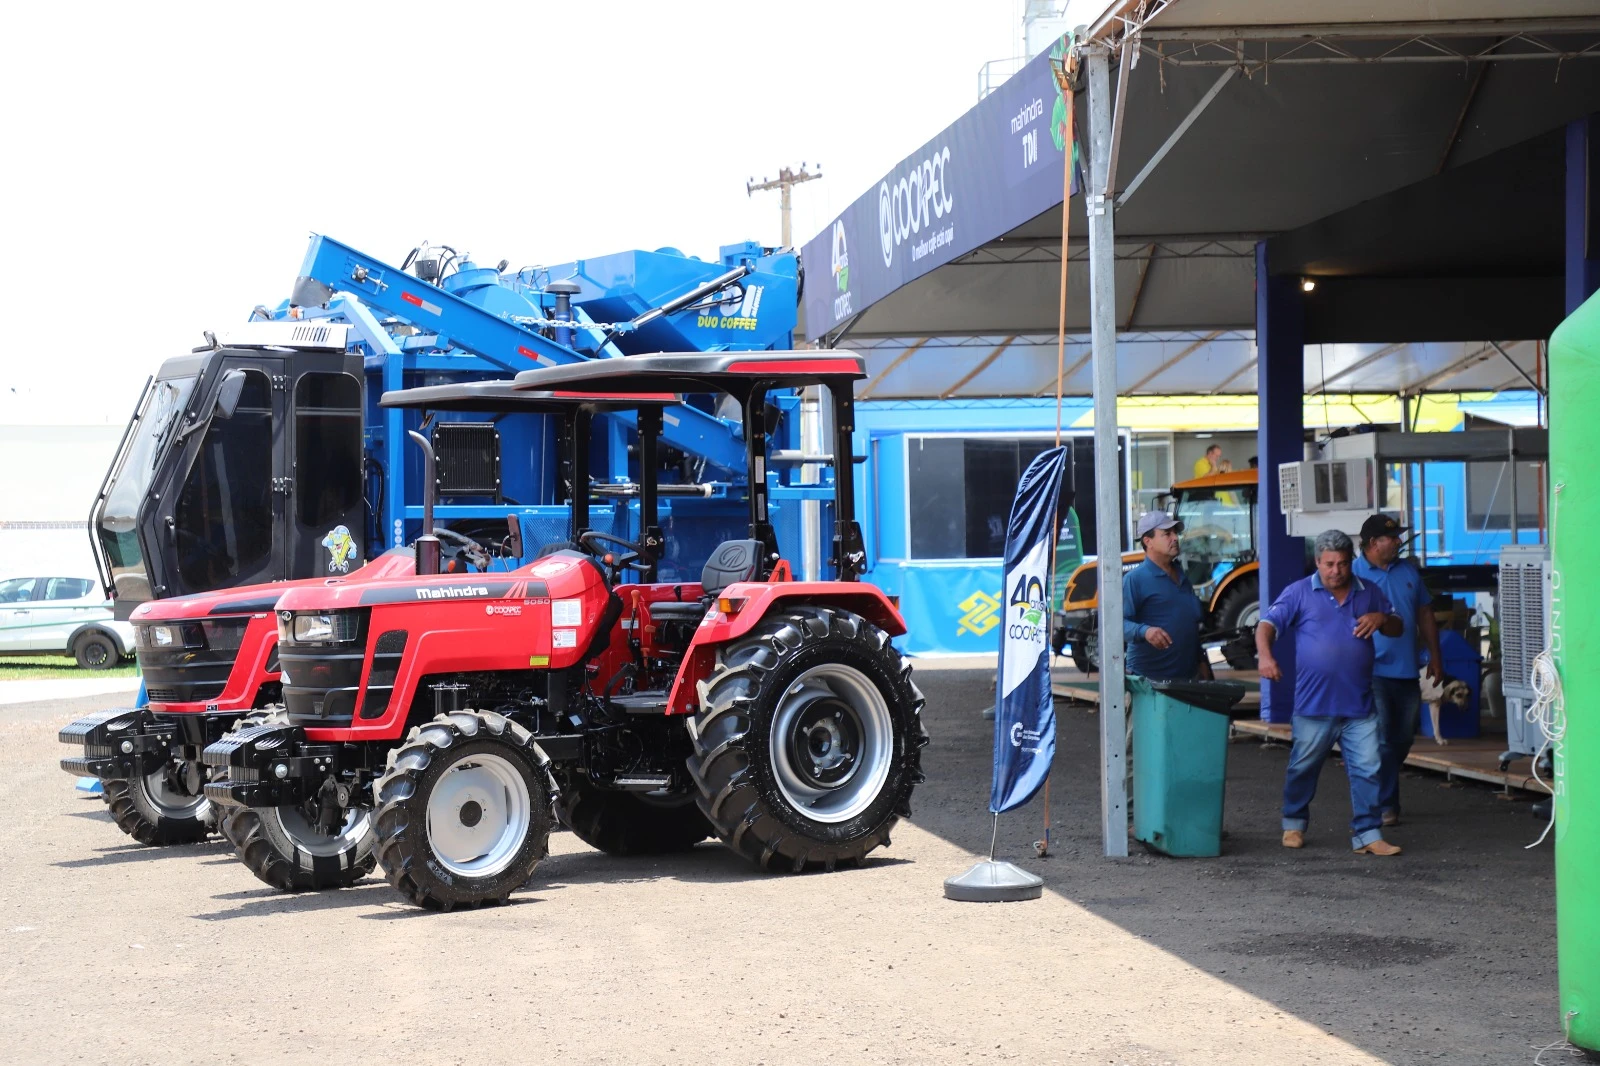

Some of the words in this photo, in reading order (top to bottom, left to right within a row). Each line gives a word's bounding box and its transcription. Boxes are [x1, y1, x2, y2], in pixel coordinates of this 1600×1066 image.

[697, 315, 718, 328] DUO
[720, 317, 758, 331] COFFEE
[1010, 574, 1043, 619] 40
